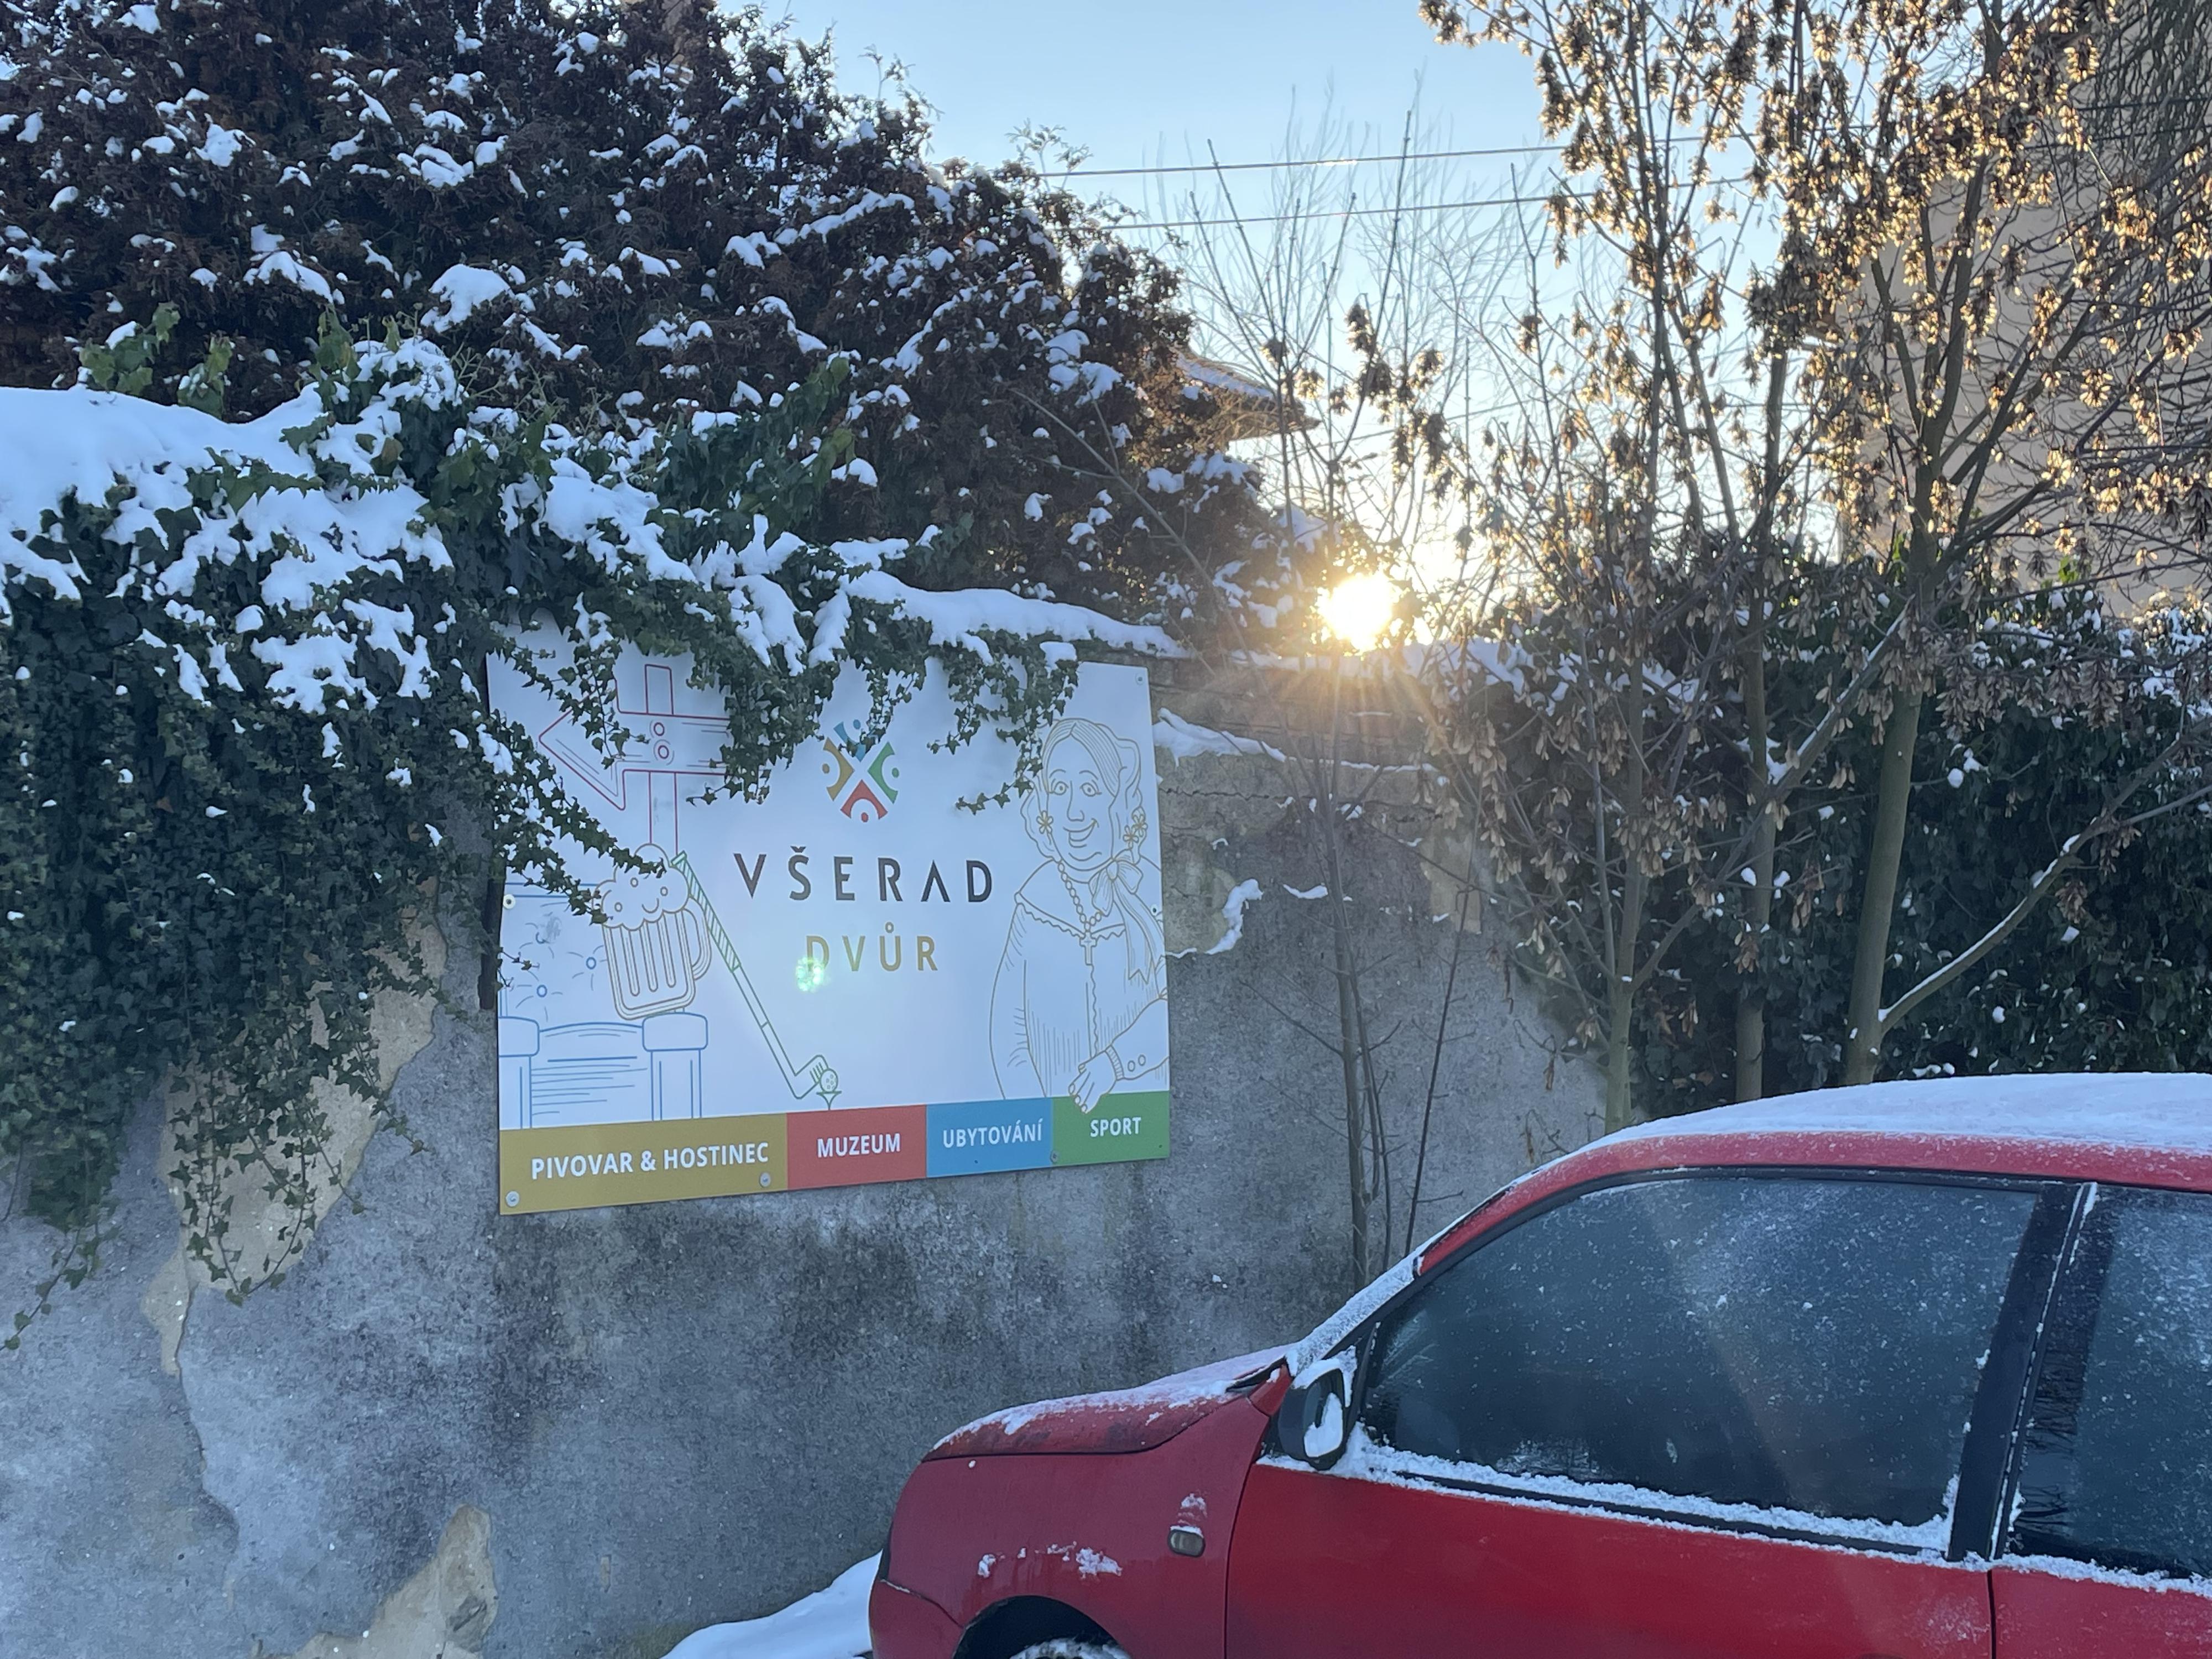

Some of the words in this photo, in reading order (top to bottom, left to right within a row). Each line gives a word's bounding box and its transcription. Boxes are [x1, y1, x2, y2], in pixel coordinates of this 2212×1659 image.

[733, 846, 993, 903] VŠERAD
[806, 922, 938, 972] DVŮR
[942, 1118, 1044, 1149] UBYTOVÁNÍ
[1090, 1116, 1141, 1138] SPORT
[531, 1151, 634, 1180] PIVOVAR
[640, 1150, 656, 1171] &
[664, 1141, 769, 1170] HOSTINEC
[817, 1133, 901, 1158] MUZEUM
